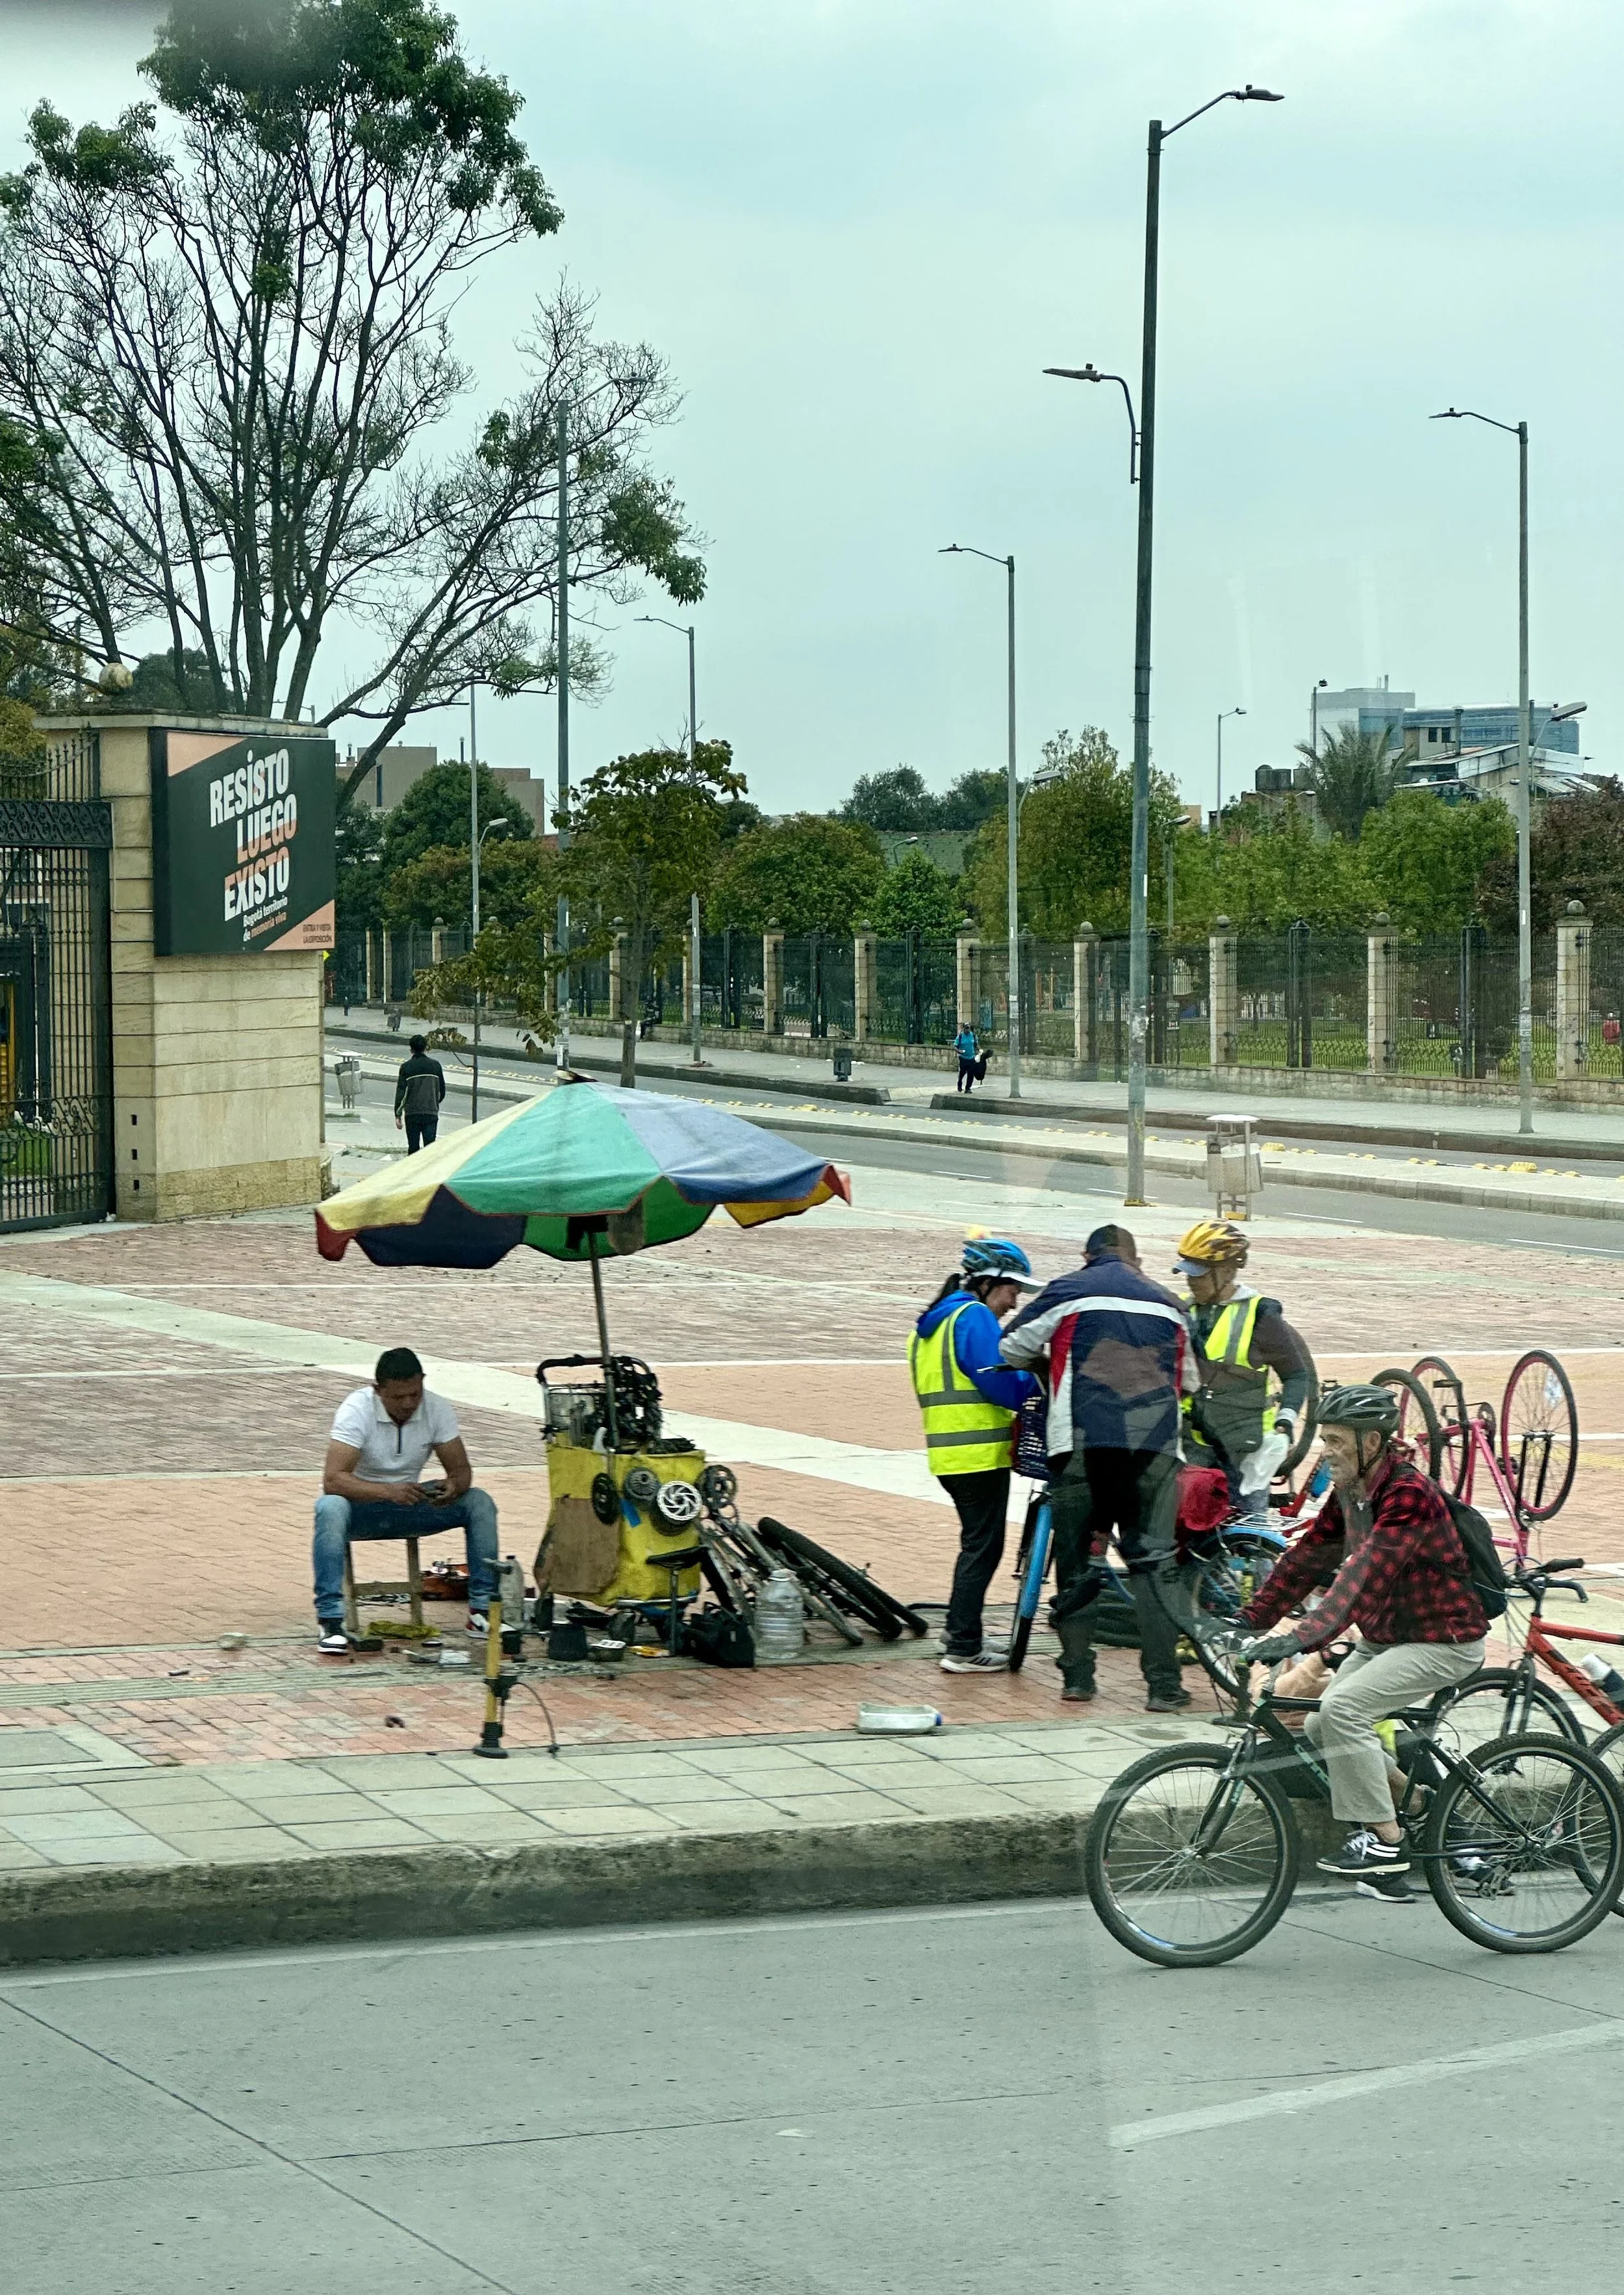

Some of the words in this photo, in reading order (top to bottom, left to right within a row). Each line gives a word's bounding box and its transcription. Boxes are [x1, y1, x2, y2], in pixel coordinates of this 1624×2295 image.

[237, 793, 298, 864] LUEGO
[225, 847, 289, 921] EXISTO
[243, 928, 251, 942] de
